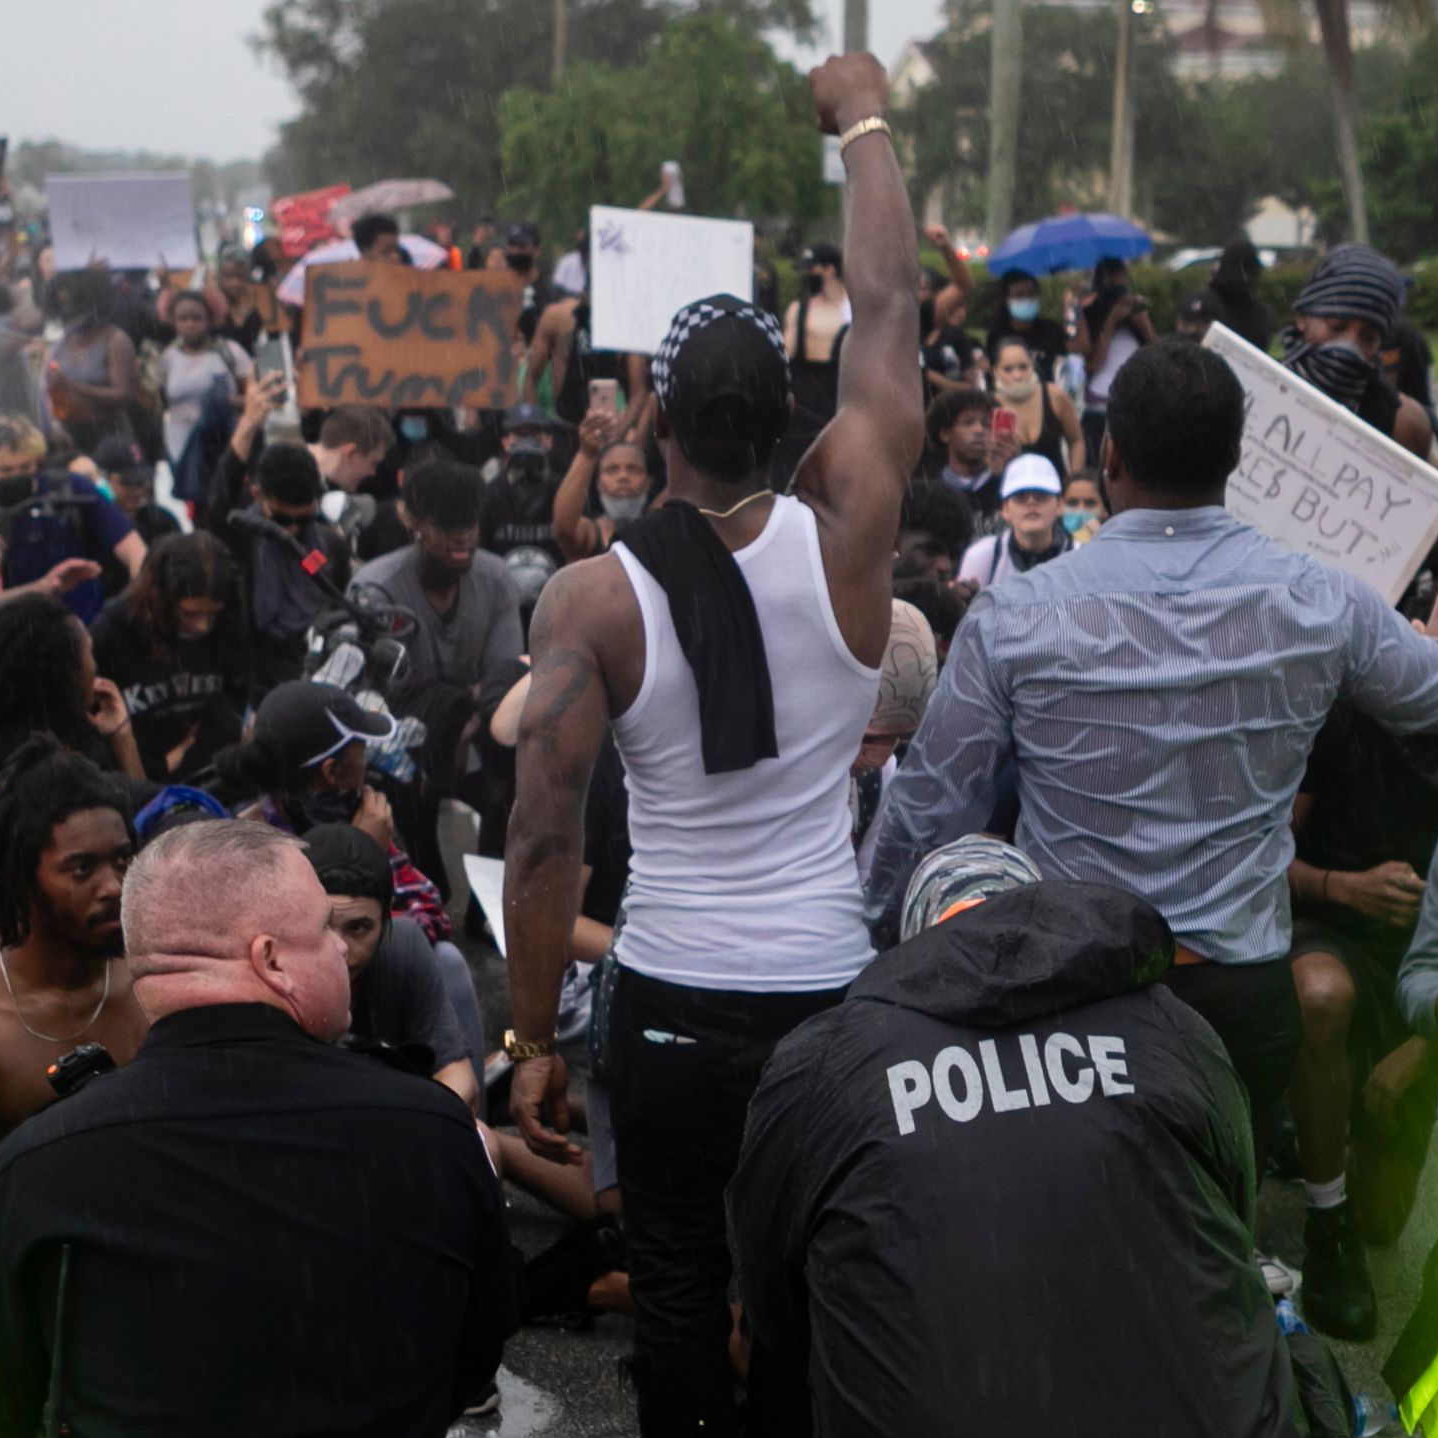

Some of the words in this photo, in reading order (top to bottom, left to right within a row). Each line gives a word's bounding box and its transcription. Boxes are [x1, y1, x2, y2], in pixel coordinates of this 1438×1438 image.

[1264, 414, 1327, 479] ALL
[1332, 463, 1411, 521] PAY
[886, 1032, 1135, 1136] POLICE
